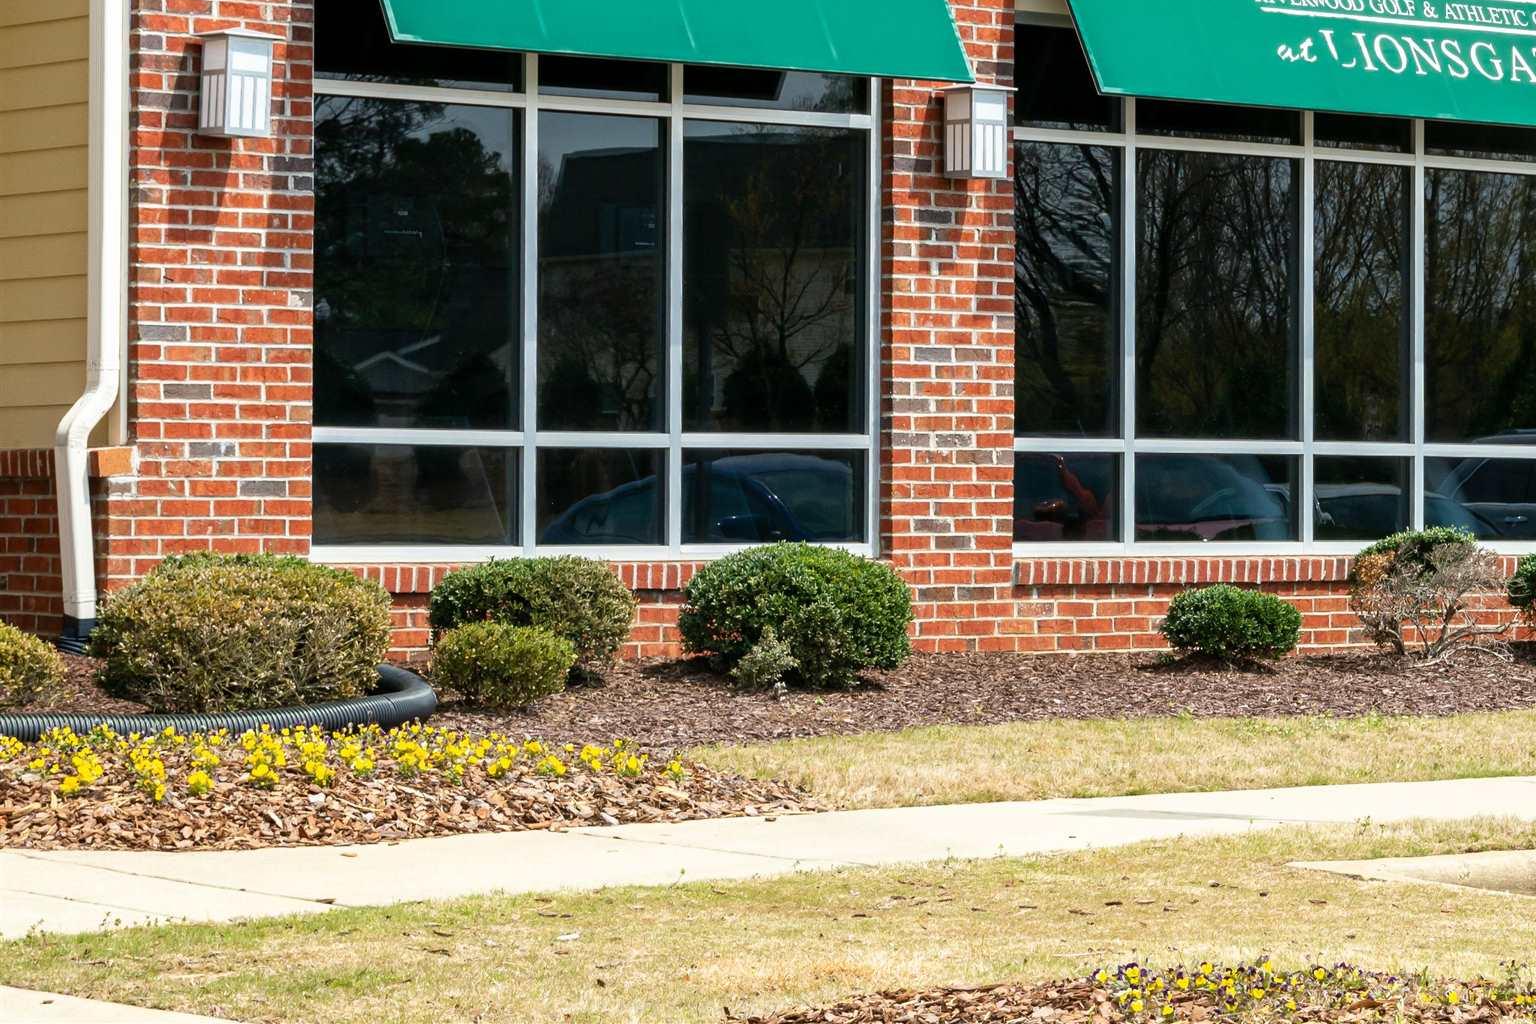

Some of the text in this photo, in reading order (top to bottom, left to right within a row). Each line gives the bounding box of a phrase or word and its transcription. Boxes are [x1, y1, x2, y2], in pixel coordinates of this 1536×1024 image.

[1423, 1, 1439, 19] &
[1444, 4, 1529, 28] ATHLETIC
[1276, 37, 1318, 65] at
